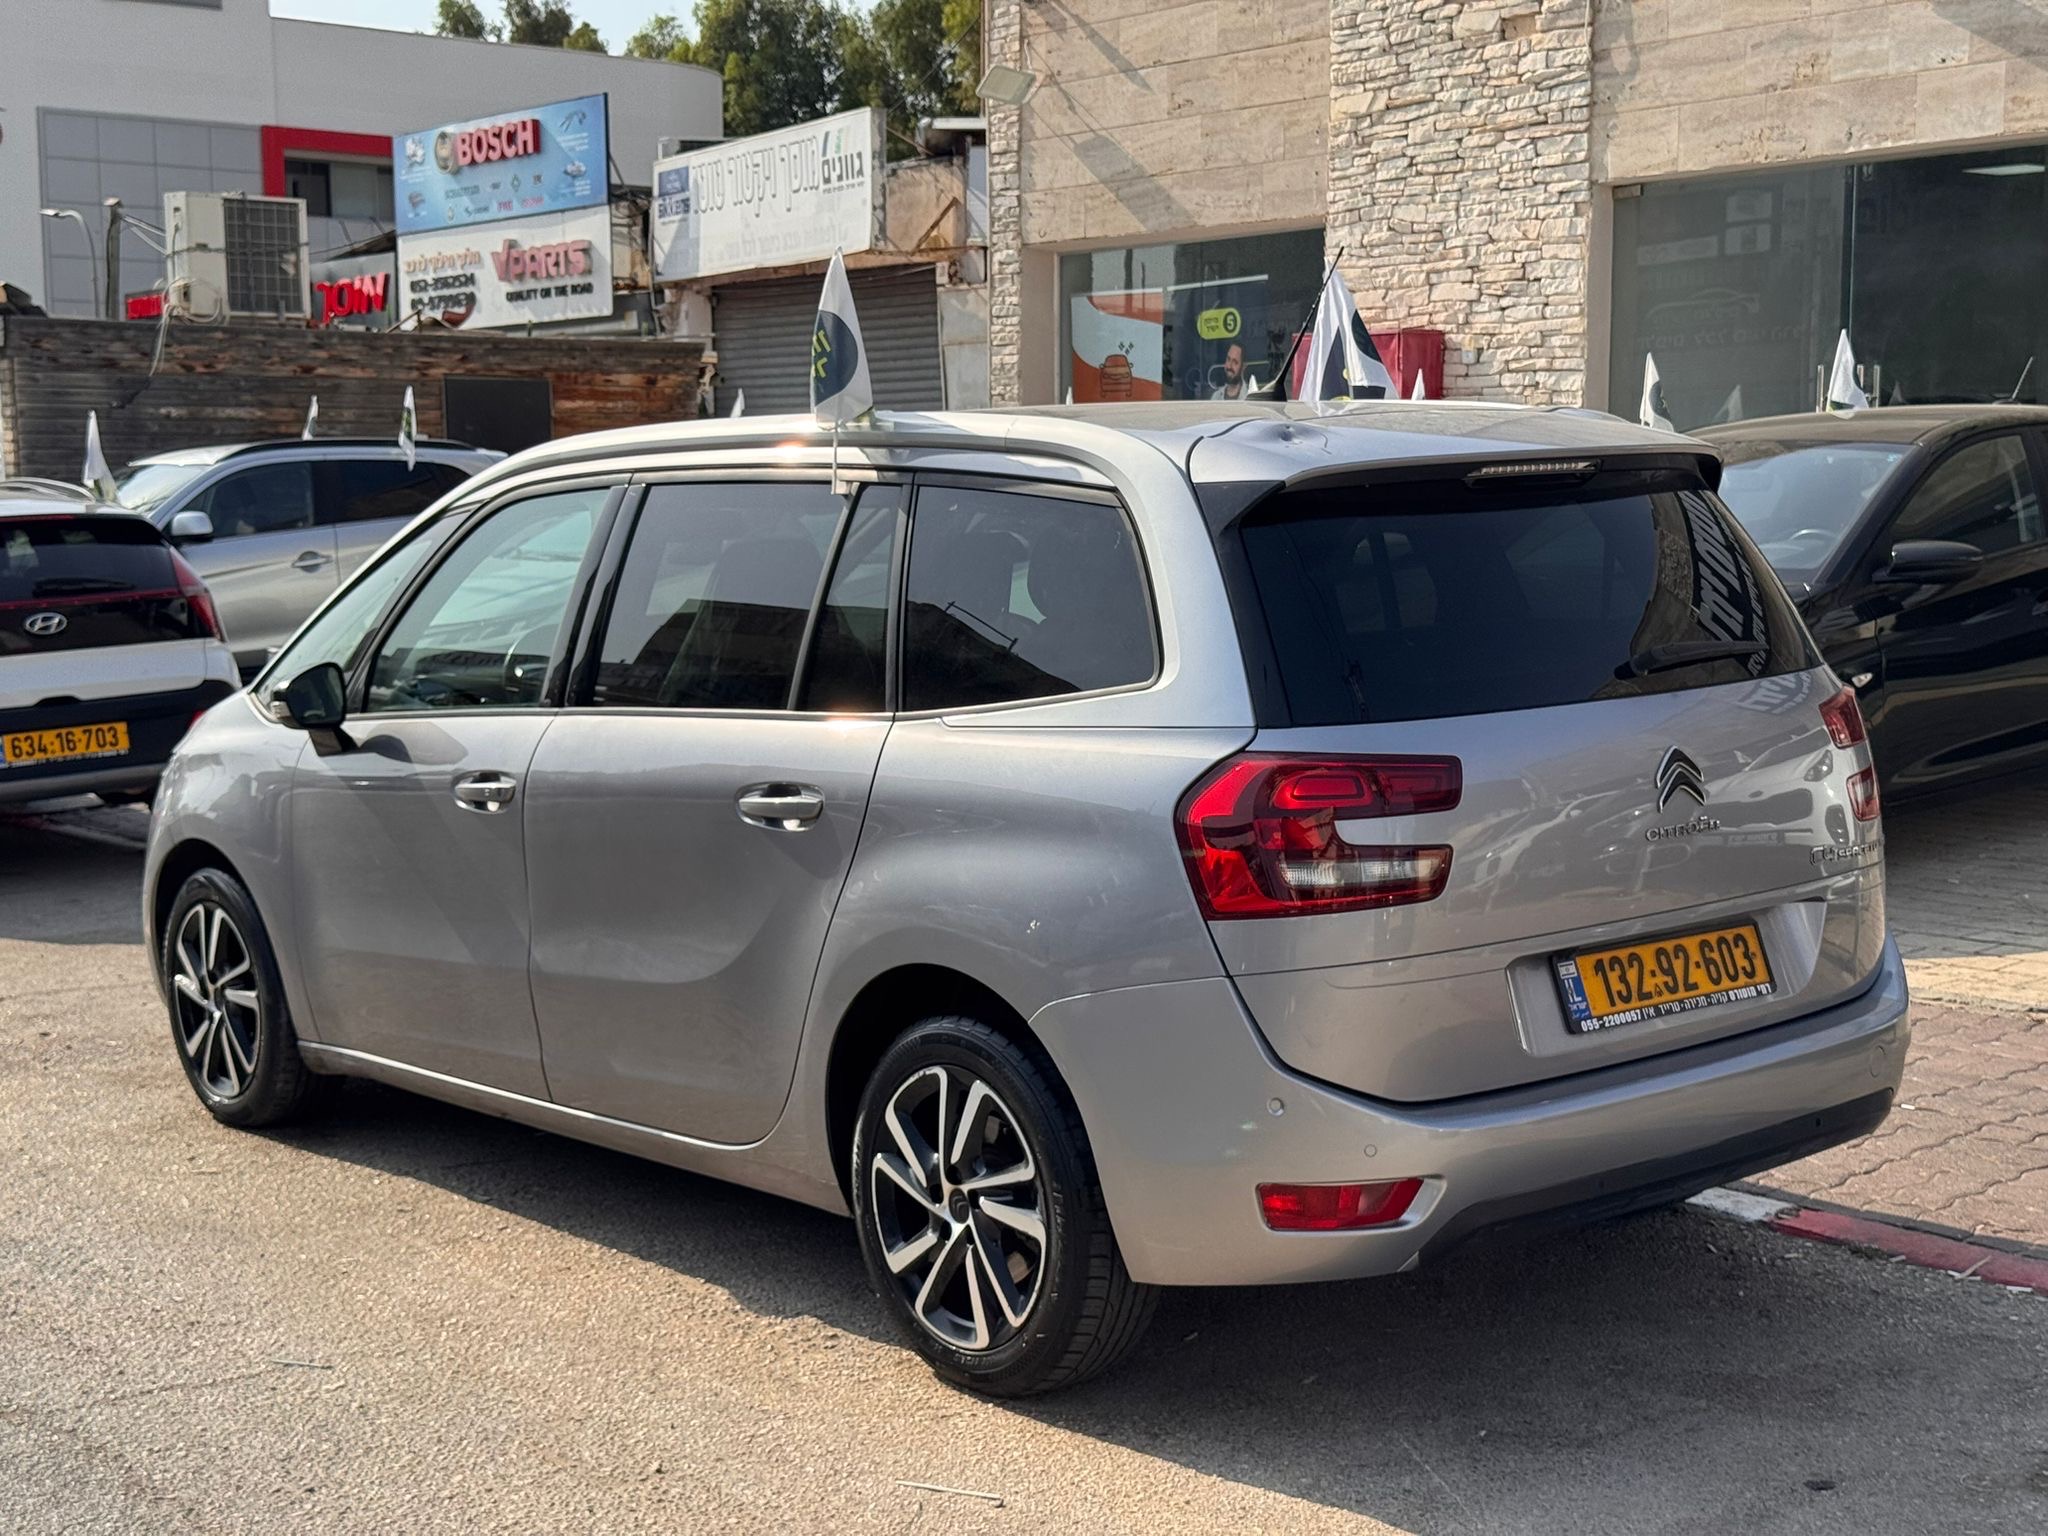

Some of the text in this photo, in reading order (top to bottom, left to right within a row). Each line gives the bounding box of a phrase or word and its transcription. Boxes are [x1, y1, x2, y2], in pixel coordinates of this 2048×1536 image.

[454, 118, 541, 167] BOSCH
[822, 151, 864, 185] גוונים
[1581, 1008, 1642, 1033] 055-2200057
